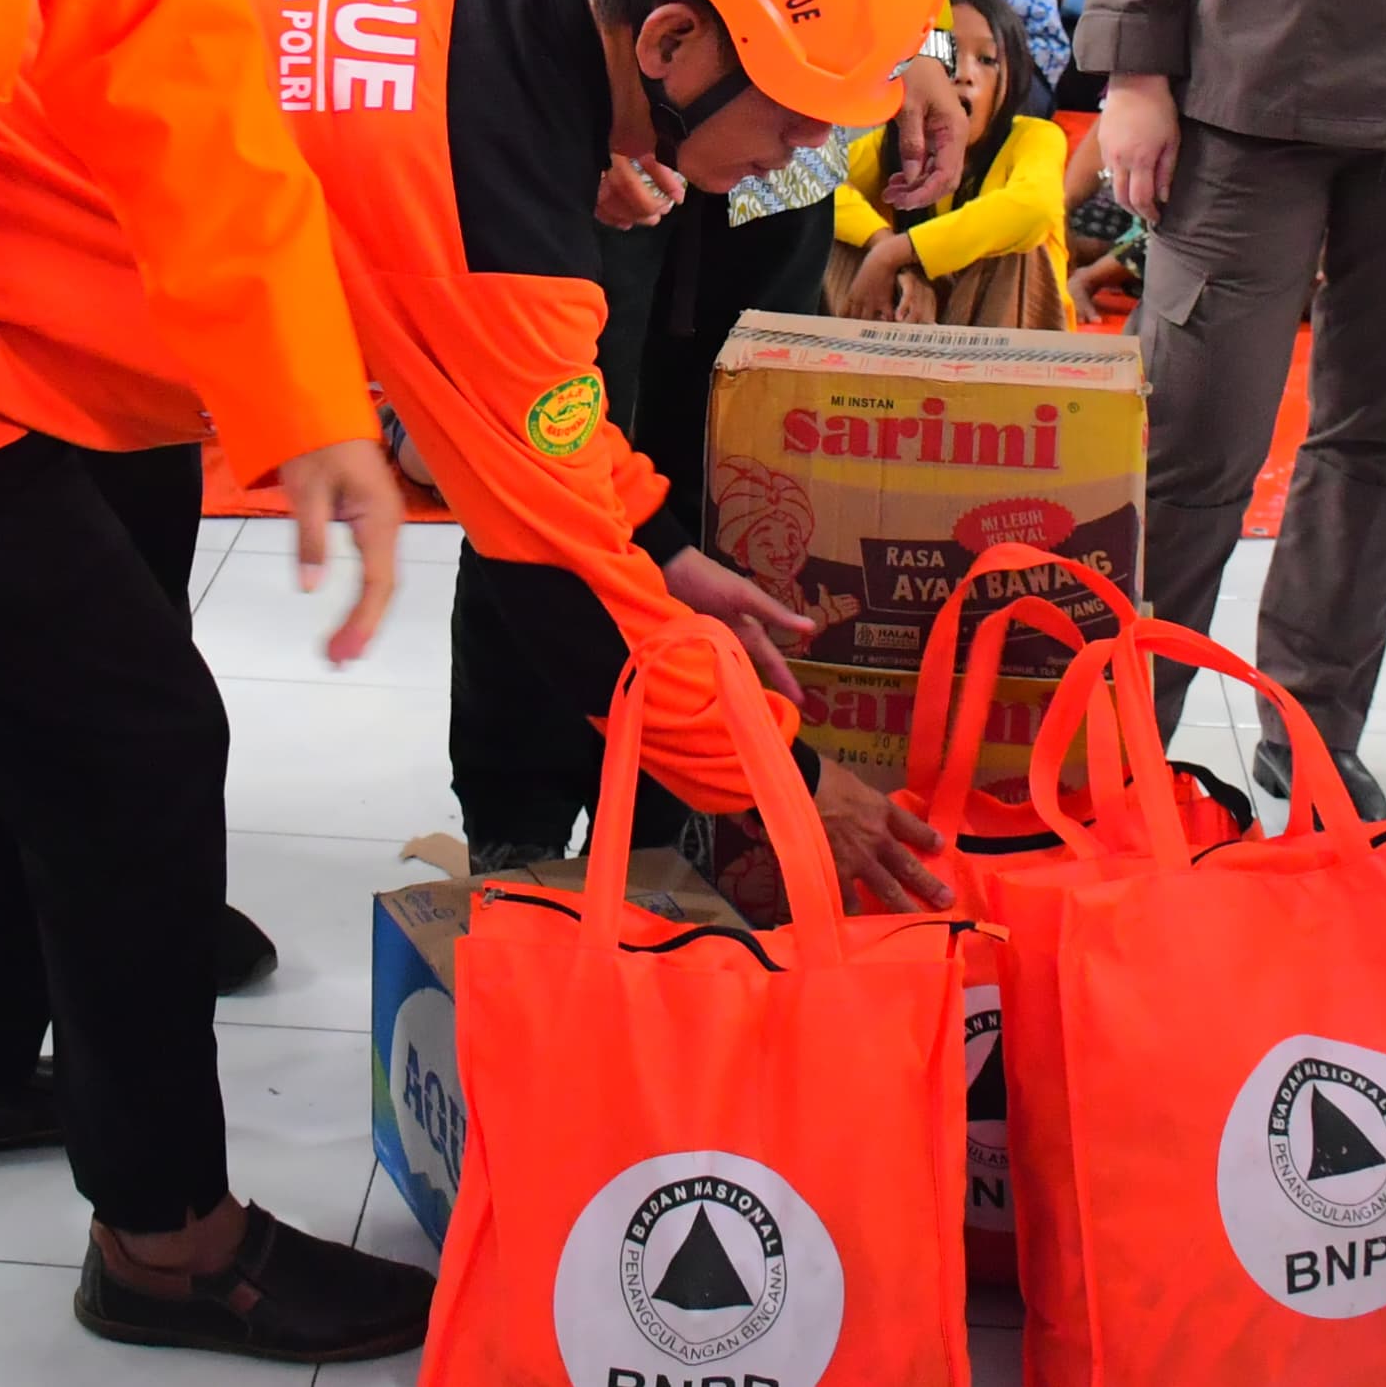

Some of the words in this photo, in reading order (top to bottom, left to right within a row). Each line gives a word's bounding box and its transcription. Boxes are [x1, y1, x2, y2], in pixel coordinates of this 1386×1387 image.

[279, 10, 313, 111] POLRI
[783, 397, 1060, 470] sarimi
[830, 394, 845, 407] MI
[847, 397, 895, 411] INSTAN
[981, 516, 998, 532] MI
[1001, 510, 1044, 528] LEBIH
[886, 546, 945, 567] RASA
[1272, 1067, 1303, 1130] BADAN
[632, 1185, 687, 1239] BADAN
[694, 1181, 779, 1252] NASIONAL
[625, 1249, 740, 1360] PENANGGULANGAN
[740, 1263, 783, 1340] BENCANA
